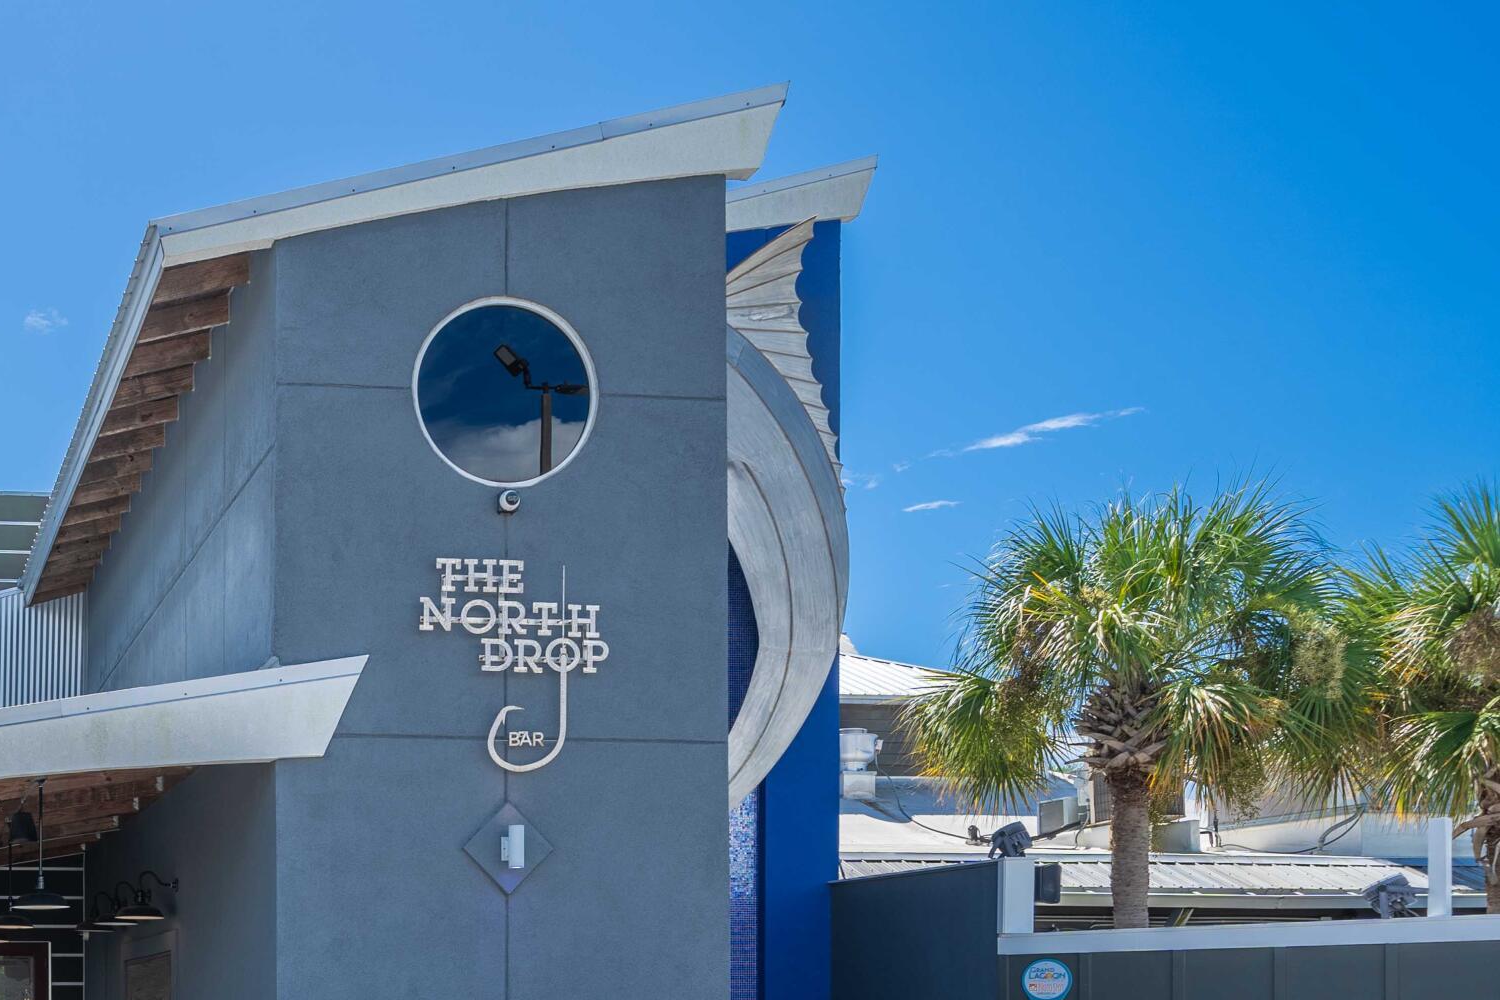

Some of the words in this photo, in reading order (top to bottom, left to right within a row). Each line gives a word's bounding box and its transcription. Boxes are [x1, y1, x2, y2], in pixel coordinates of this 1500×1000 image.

[436, 558, 524, 593] THE
[419, 597, 600, 638] NORTH
[480, 637, 609, 673] DROP
[508, 730, 544, 747] BAR
